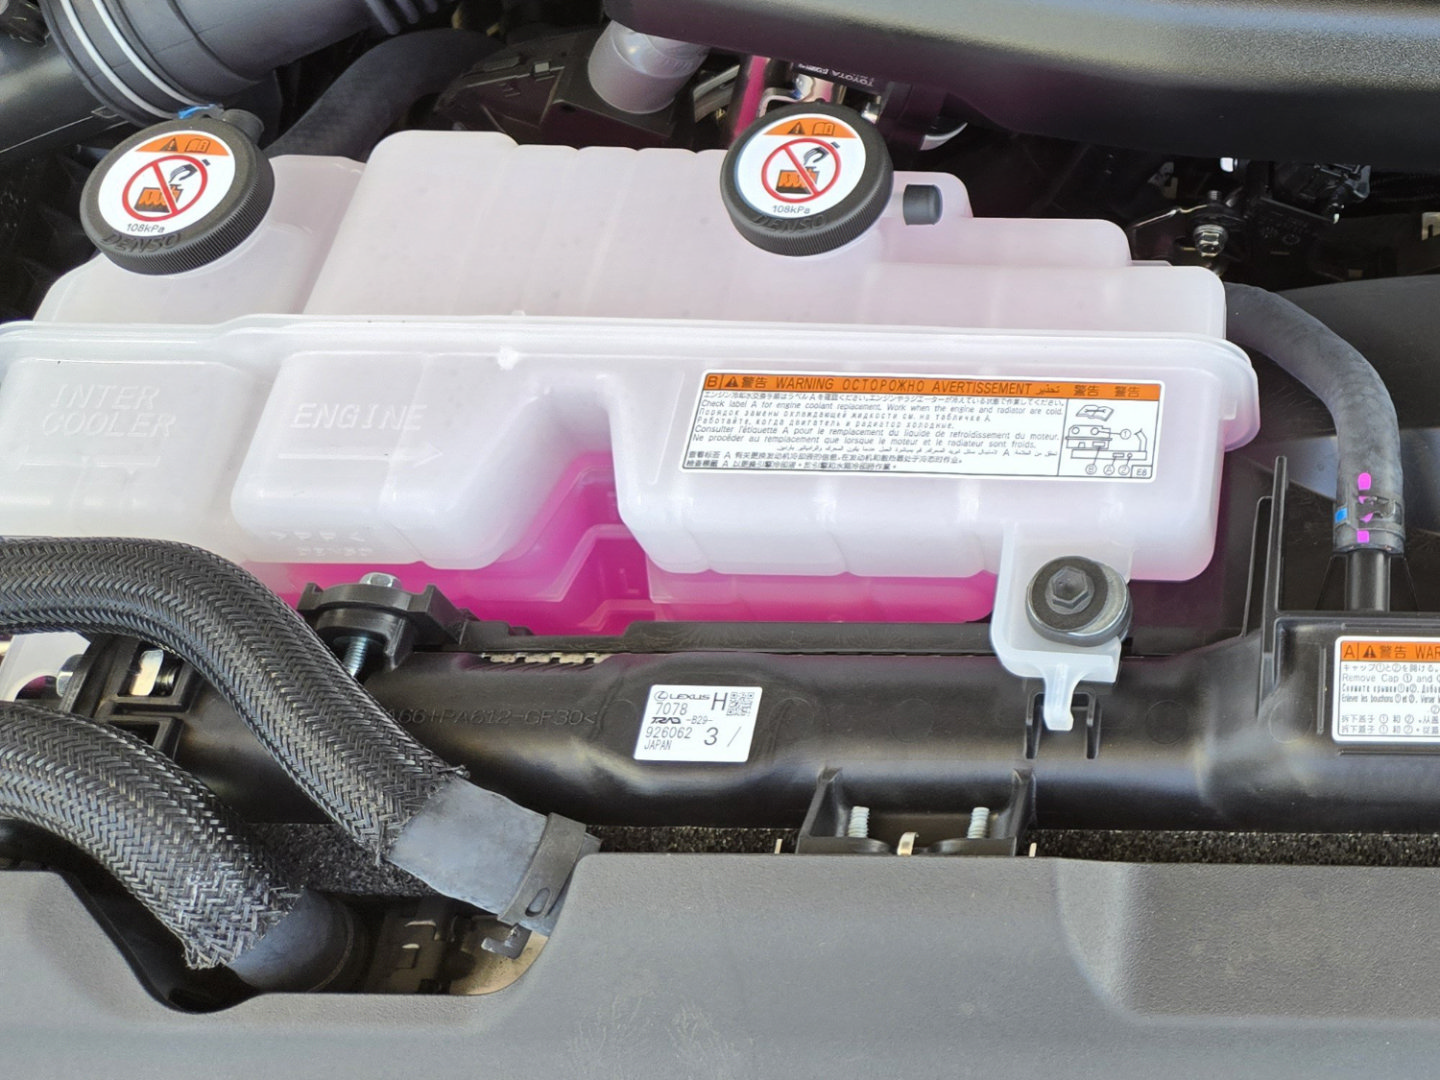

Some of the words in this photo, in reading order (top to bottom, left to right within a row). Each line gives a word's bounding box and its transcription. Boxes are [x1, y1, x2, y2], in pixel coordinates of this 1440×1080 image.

[126, 223, 165, 233] 108kPa
[103, 233, 181, 251] DENSO
[707, 376, 718, 388] B
[776, 377, 834, 390] WARNING
[932, 381, 1032, 394] AVERTISSEMENT
[51, 385, 160, 409] INTER
[294, 404, 427, 431] ENGINE
[950, 406, 975, 414] engine
[42, 412, 176, 437] COOLER
[695, 425, 734, 433] Consulter
[829, 429, 884, 437] remplacement
[889, 429, 899, 437] du
[904, 430, 930, 438] liquide
[950, 431, 1010, 439] refroidissement
[1015, 432, 1025, 440] du
[764, 436, 819, 444] remplacement
[844, 437, 874, 445] lorsque
[1344, 645, 1355, 659] A
[1380, 645, 1408, 659] 警告
[1342, 674, 1376, 682] Remove
[1381, 674, 1399, 682] Cap
[1416, 675, 1433, 683] and
[655, 702, 688, 716] 7078
[711, 692, 728, 711] H
[645, 727, 693, 739] 926062
[704, 727, 719, 746] 3
[644, 740, 672, 750] JAPAN
